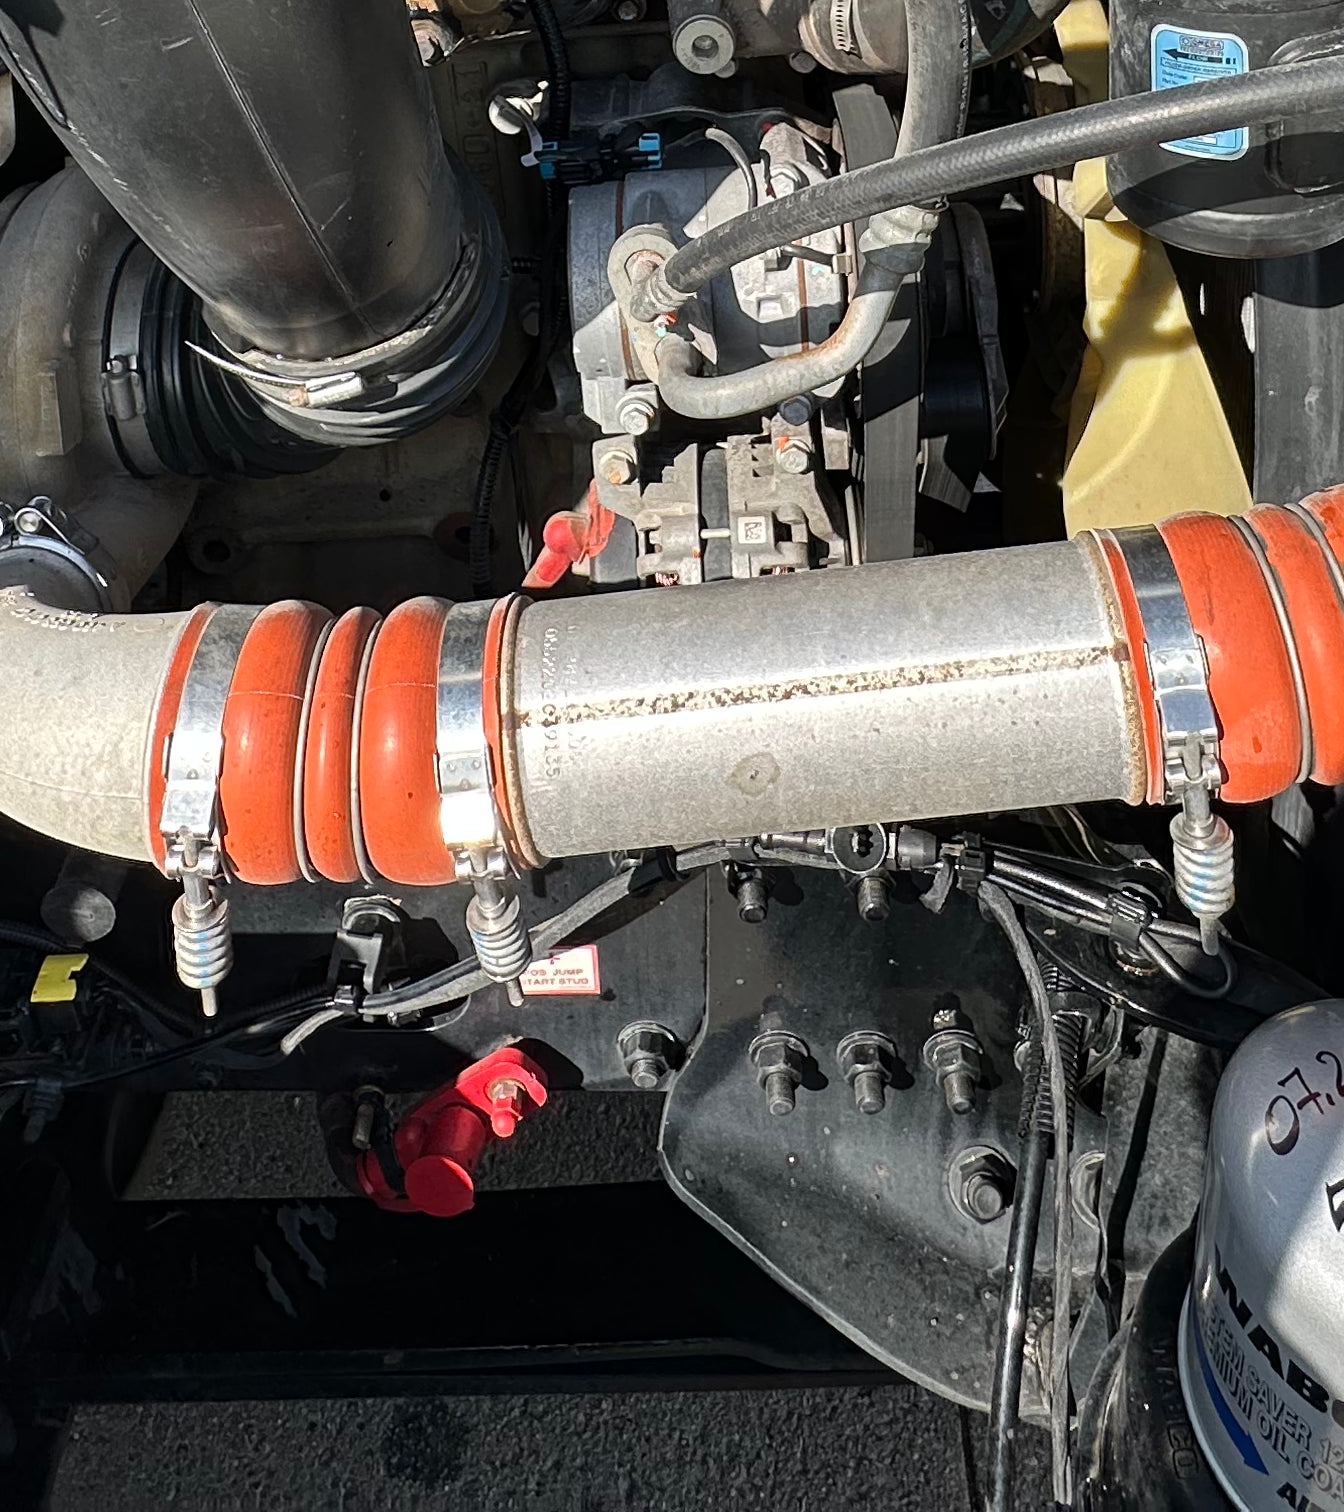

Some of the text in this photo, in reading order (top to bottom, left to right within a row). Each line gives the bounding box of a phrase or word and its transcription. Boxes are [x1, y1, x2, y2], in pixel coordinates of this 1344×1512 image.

[553, 968, 584, 976] JUMP
[558, 977, 589, 985] STUD
[1246, 1364, 1313, 1452] SAVER
[1258, 1410, 1291, 1465] OIL
